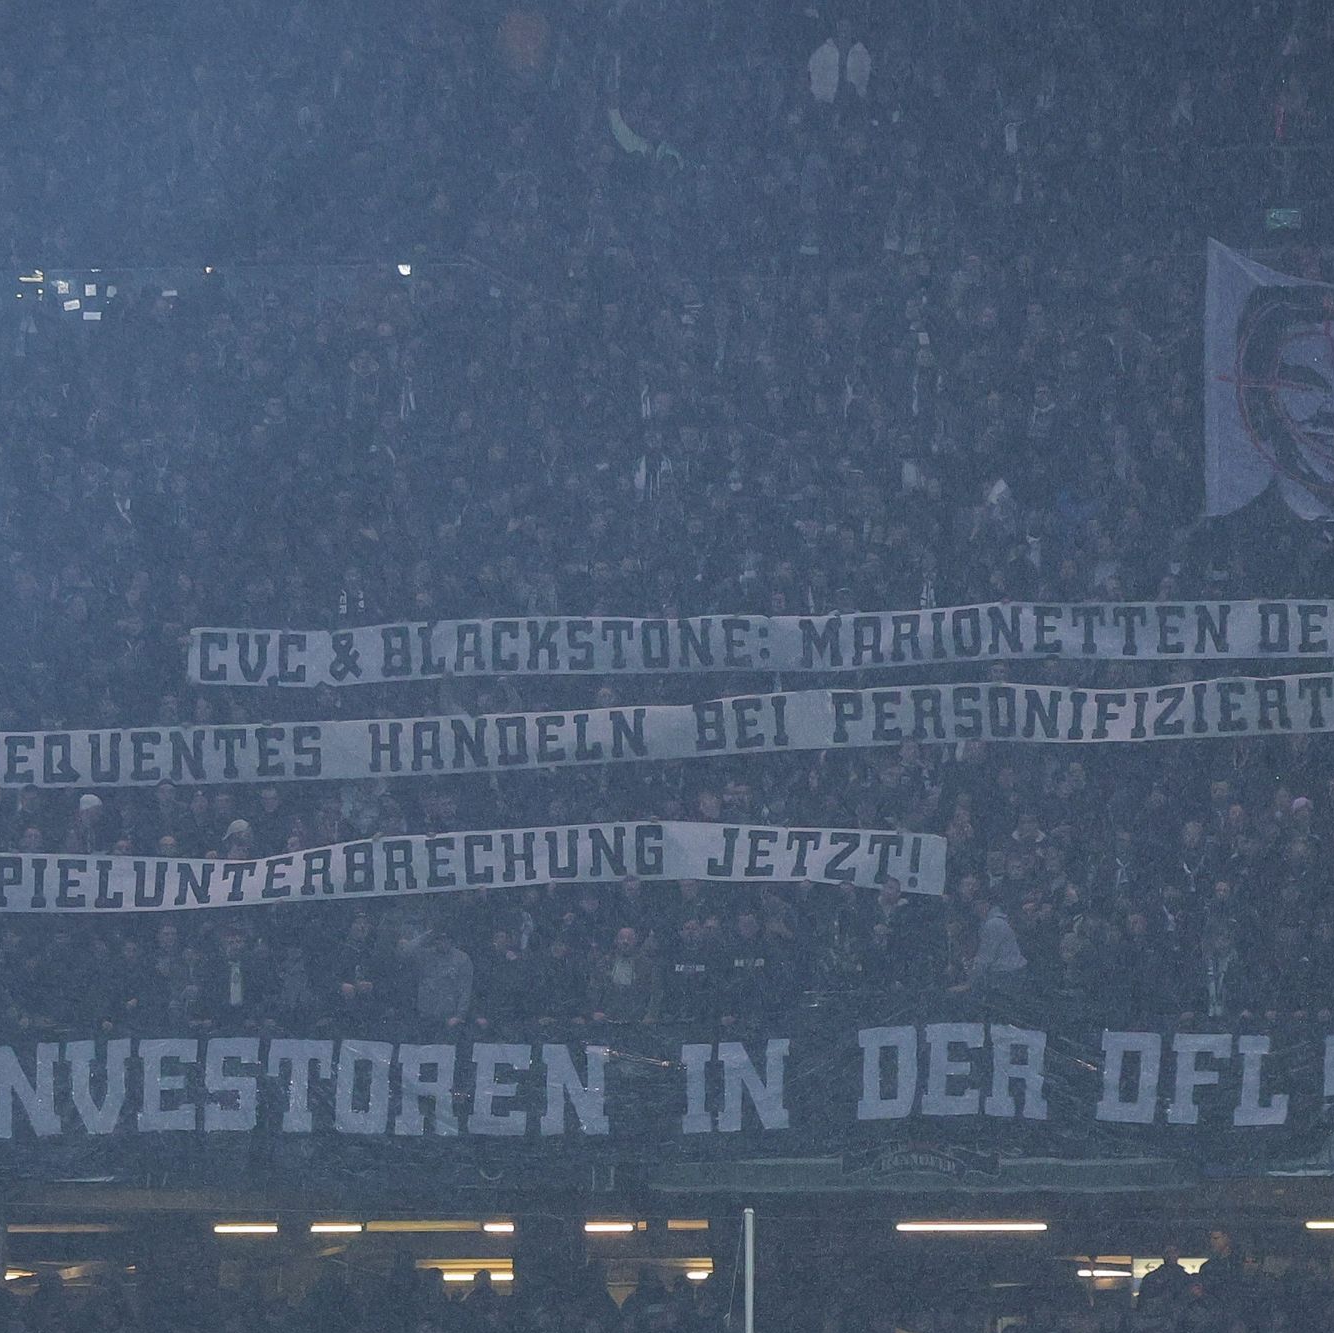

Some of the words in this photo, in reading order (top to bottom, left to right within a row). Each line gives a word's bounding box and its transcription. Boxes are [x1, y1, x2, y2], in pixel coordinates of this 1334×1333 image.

[200, 631, 307, 683] CVC
[329, 632, 363, 682] &
[381, 613, 770, 678] BLACKSTONE:
[799, 604, 1229, 667] MARIONETTEN
[368, 707, 648, 774] HANDELN
[693, 695, 789, 750] BEI
[707, 827, 921, 888] JETZT!
[680, 1038, 790, 1133] IN
[858, 1023, 1048, 1121] DER
[1095, 1030, 1289, 1127] DFL
